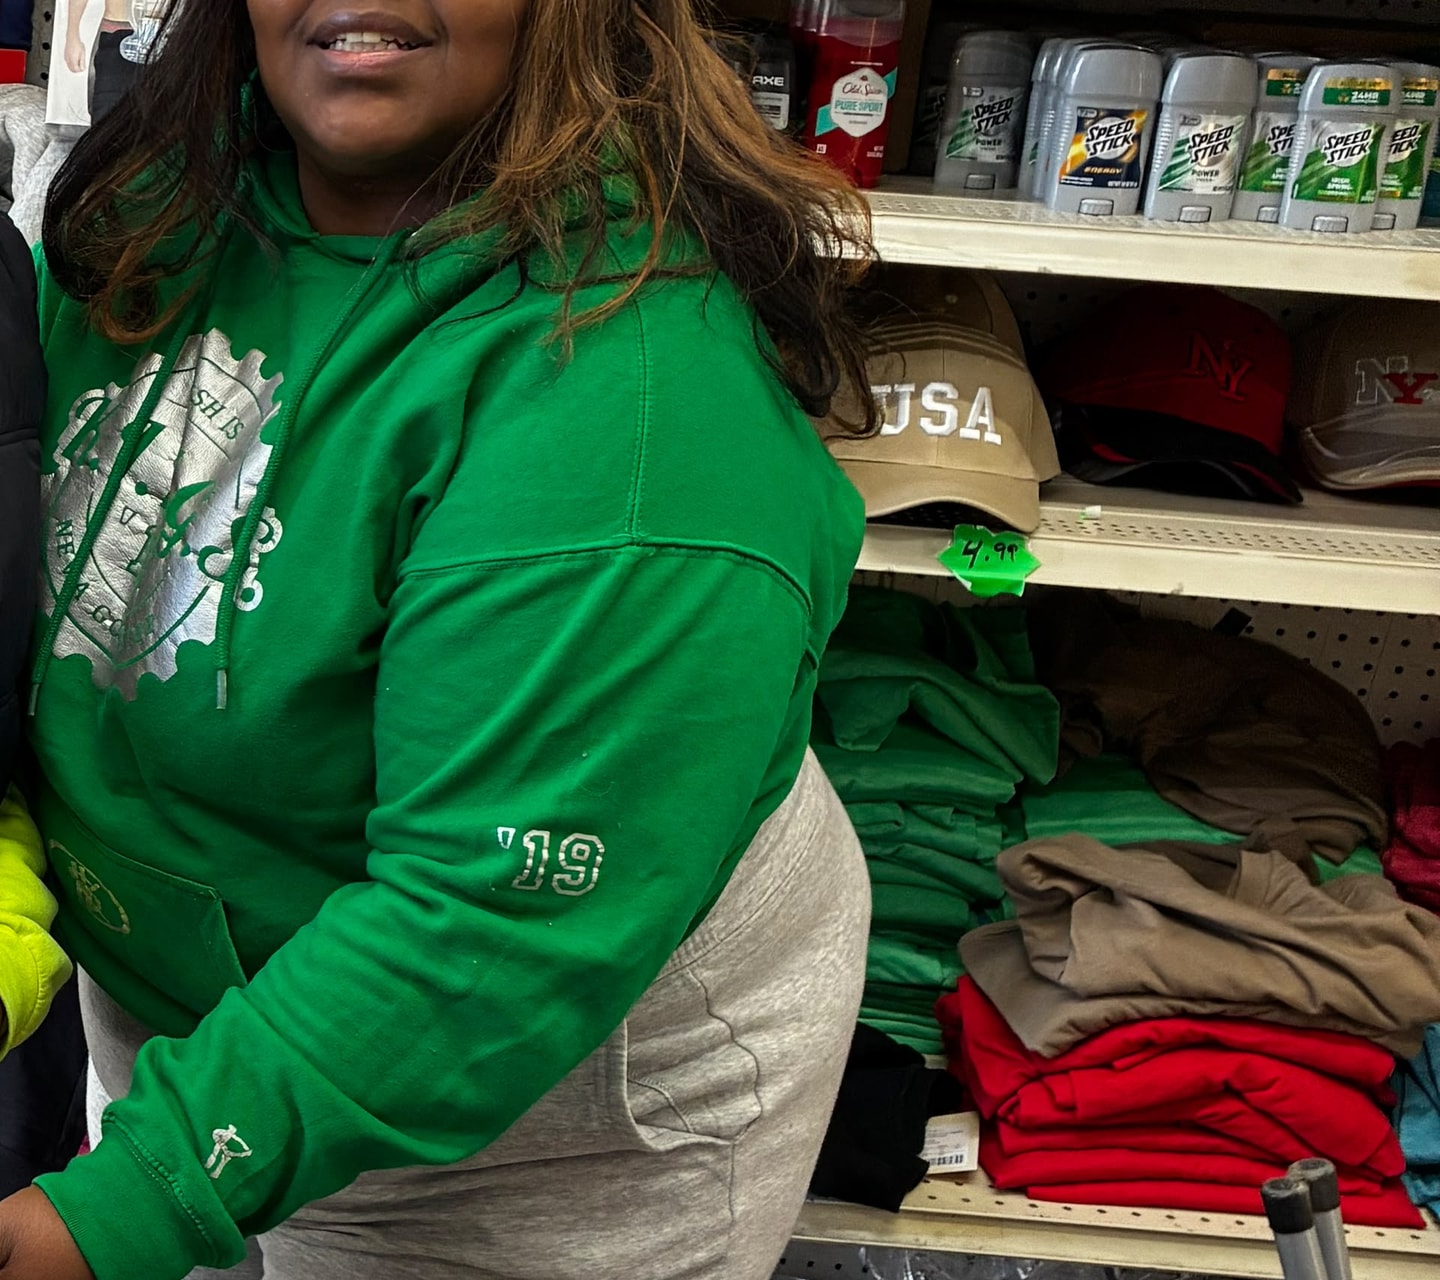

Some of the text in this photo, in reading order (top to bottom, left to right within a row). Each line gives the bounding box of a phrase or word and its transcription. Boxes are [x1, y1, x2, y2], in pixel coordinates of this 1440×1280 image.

[752, 75, 784, 86] AXE
[835, 99, 883, 113] PURE SPORT
[972, 97, 1014, 120] SPEED
[975, 111, 1012, 134] STICK
[1086, 119, 1135, 143] SPEED
[1088, 133, 1133, 157] STICK
[1188, 126, 1234, 149] SPEED
[1324, 129, 1371, 151] SPEED
[1191, 140, 1231, 163] STICK
[1326, 142, 1369, 164] STICK
[1084, 167, 1122, 175] ENERGY
[871, 382, 1002, 445] USA
